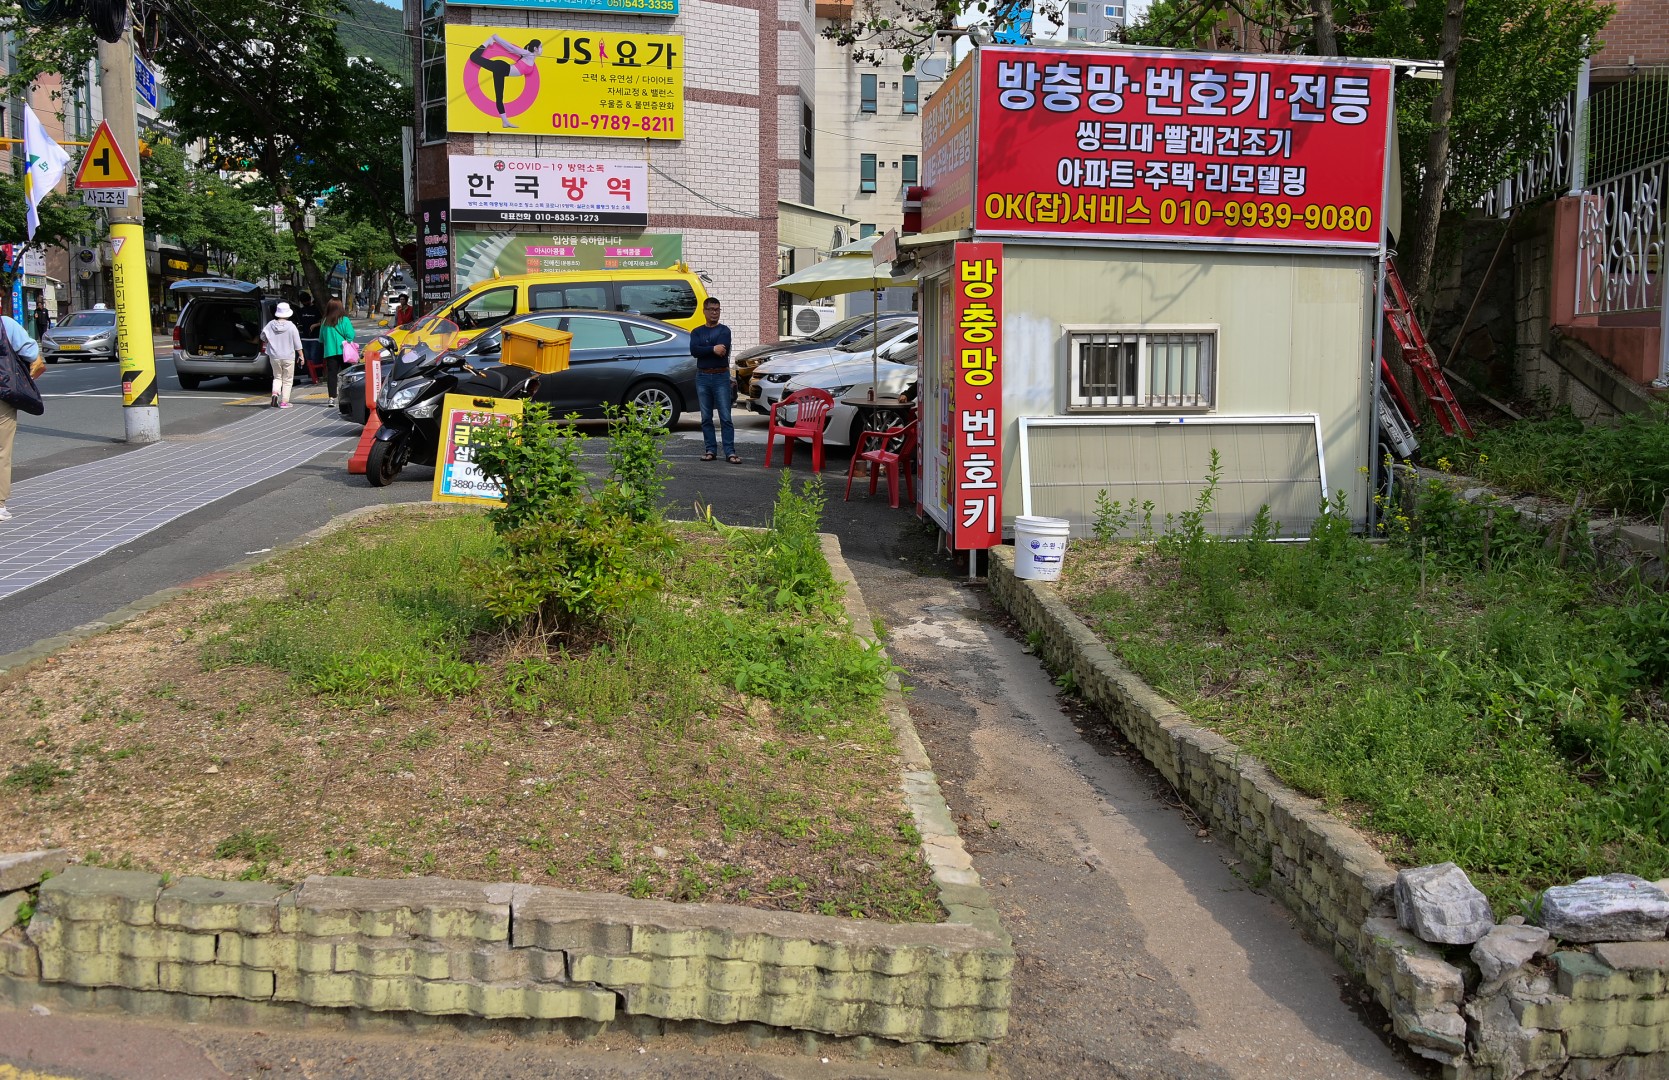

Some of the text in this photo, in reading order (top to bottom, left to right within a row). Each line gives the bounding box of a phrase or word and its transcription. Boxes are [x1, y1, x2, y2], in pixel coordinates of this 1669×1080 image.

[556, 37, 677, 69] JS 요가
[582, 73, 598, 83] 근력
[600, 74, 607, 82] &
[609, 74, 633, 84] 유연성
[642, 75, 674, 85] 다이어트
[607, 87, 674, 98] 자세교정 & 밸런스
[599, 99, 674, 110] 우울증 & 불면증완화
[552, 112, 674, 132] 010-9789-8211
[567, 163, 604, 172] 방역소독
[87, 190, 125, 205] 사고조심
[500, 212, 599, 222] 대표전화 010-8353-1273
[1160, 198, 1372, 232] 010-9939-9080
[552, 235, 578, 246] 입상을
[114, 263, 128, 353] 어린이보호구역
